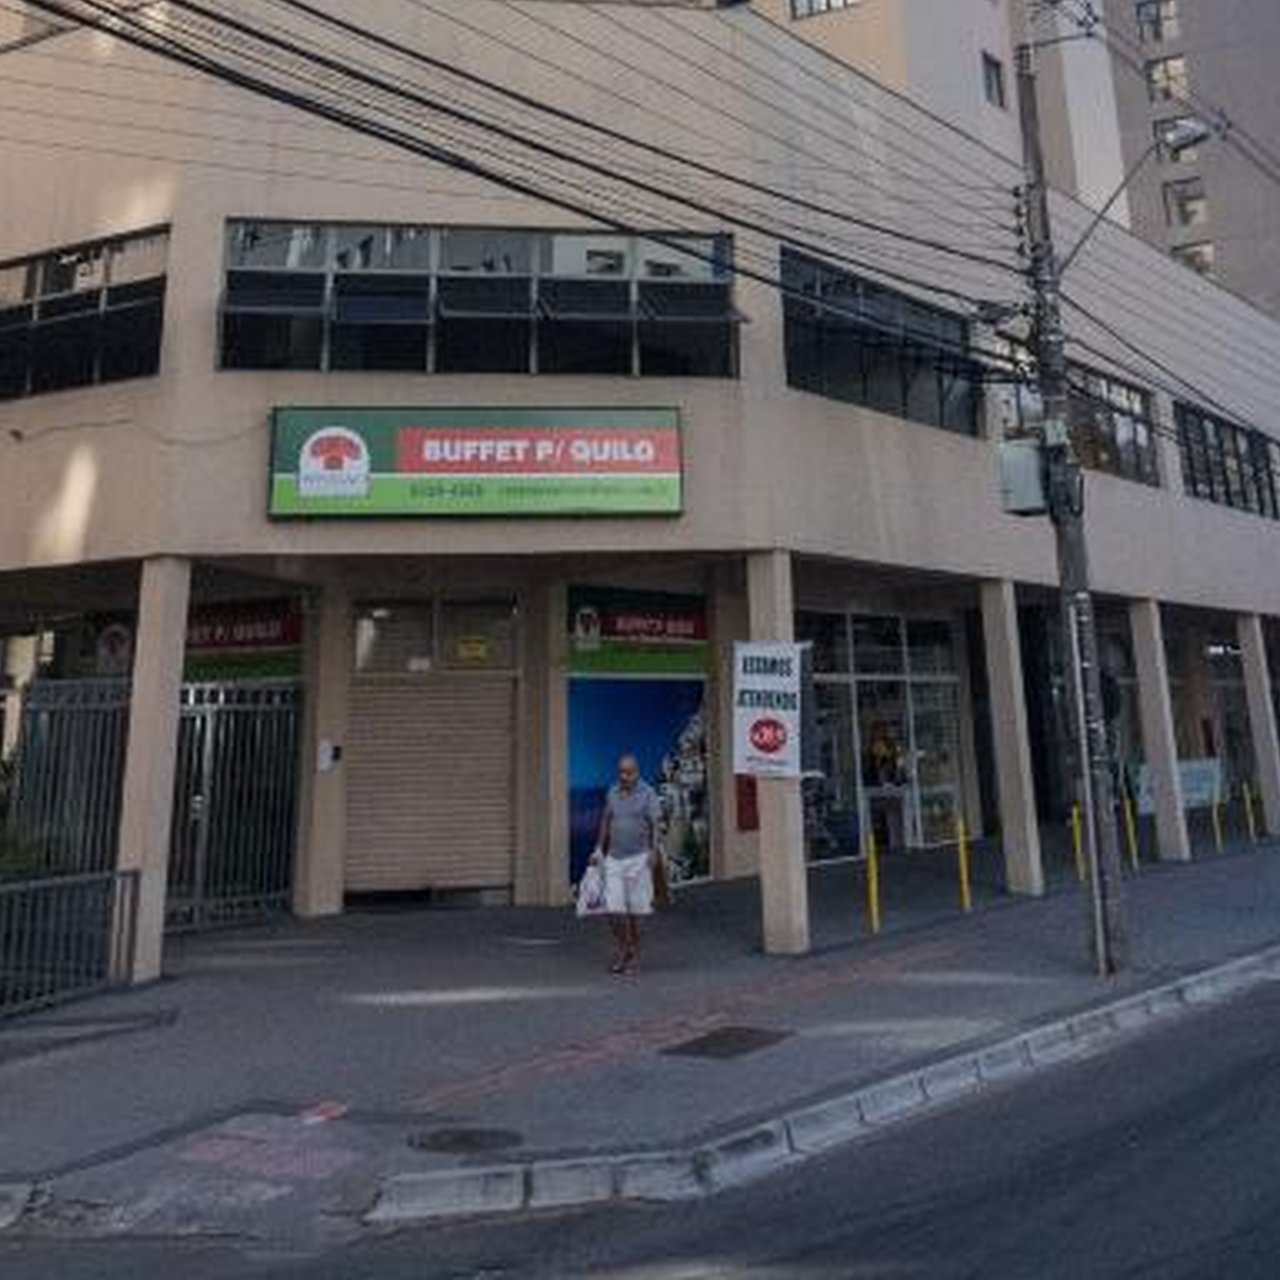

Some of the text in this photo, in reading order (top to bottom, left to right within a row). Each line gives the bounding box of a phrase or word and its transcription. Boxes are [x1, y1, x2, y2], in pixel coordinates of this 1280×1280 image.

[423, 439, 655, 464] BUFFET P/ QUILO
